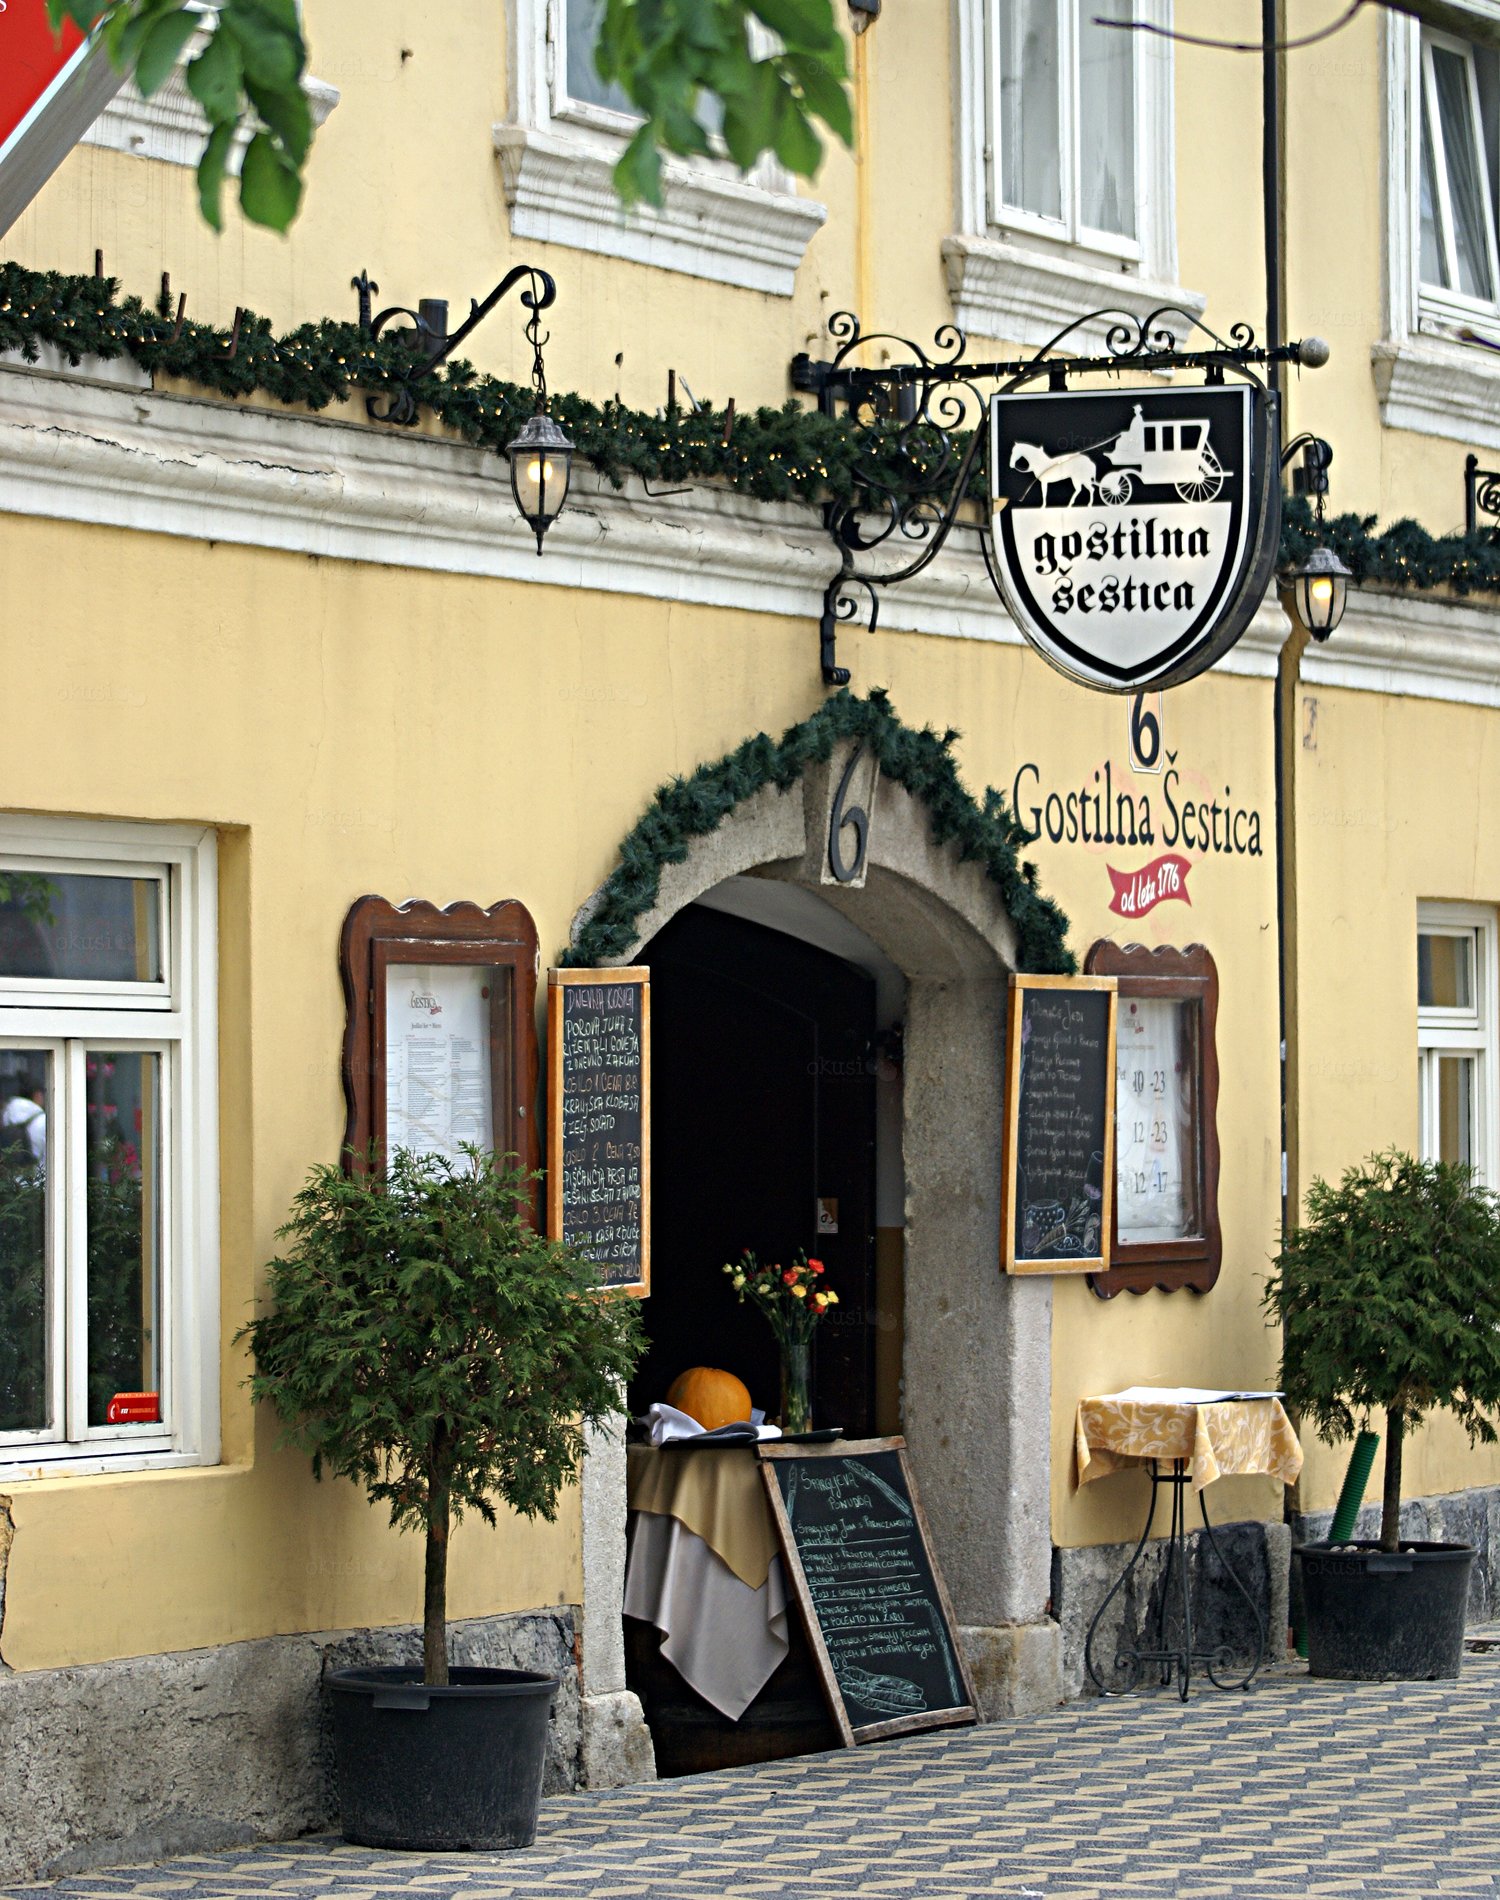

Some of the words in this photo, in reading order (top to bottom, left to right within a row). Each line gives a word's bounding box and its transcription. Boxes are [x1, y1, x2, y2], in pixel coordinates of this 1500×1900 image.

[1033, 517, 1211, 576] gostilna
[1051, 565, 1196, 615] šestica
[1132, 692, 1160, 767] 6
[828, 742, 870, 882] 6
[1013, 760, 1155, 846] Gostilna
[1162, 750, 1263, 857] Šestica
[1121, 892, 1136, 912] od
[1137, 875, 1157, 909] leta
[1157, 862, 1181, 896] 1776
[601, 1015, 626, 1035] JUHA
[1133, 1121, 1145, 1143] 12
[1134, 1172, 1146, 1194] 12
